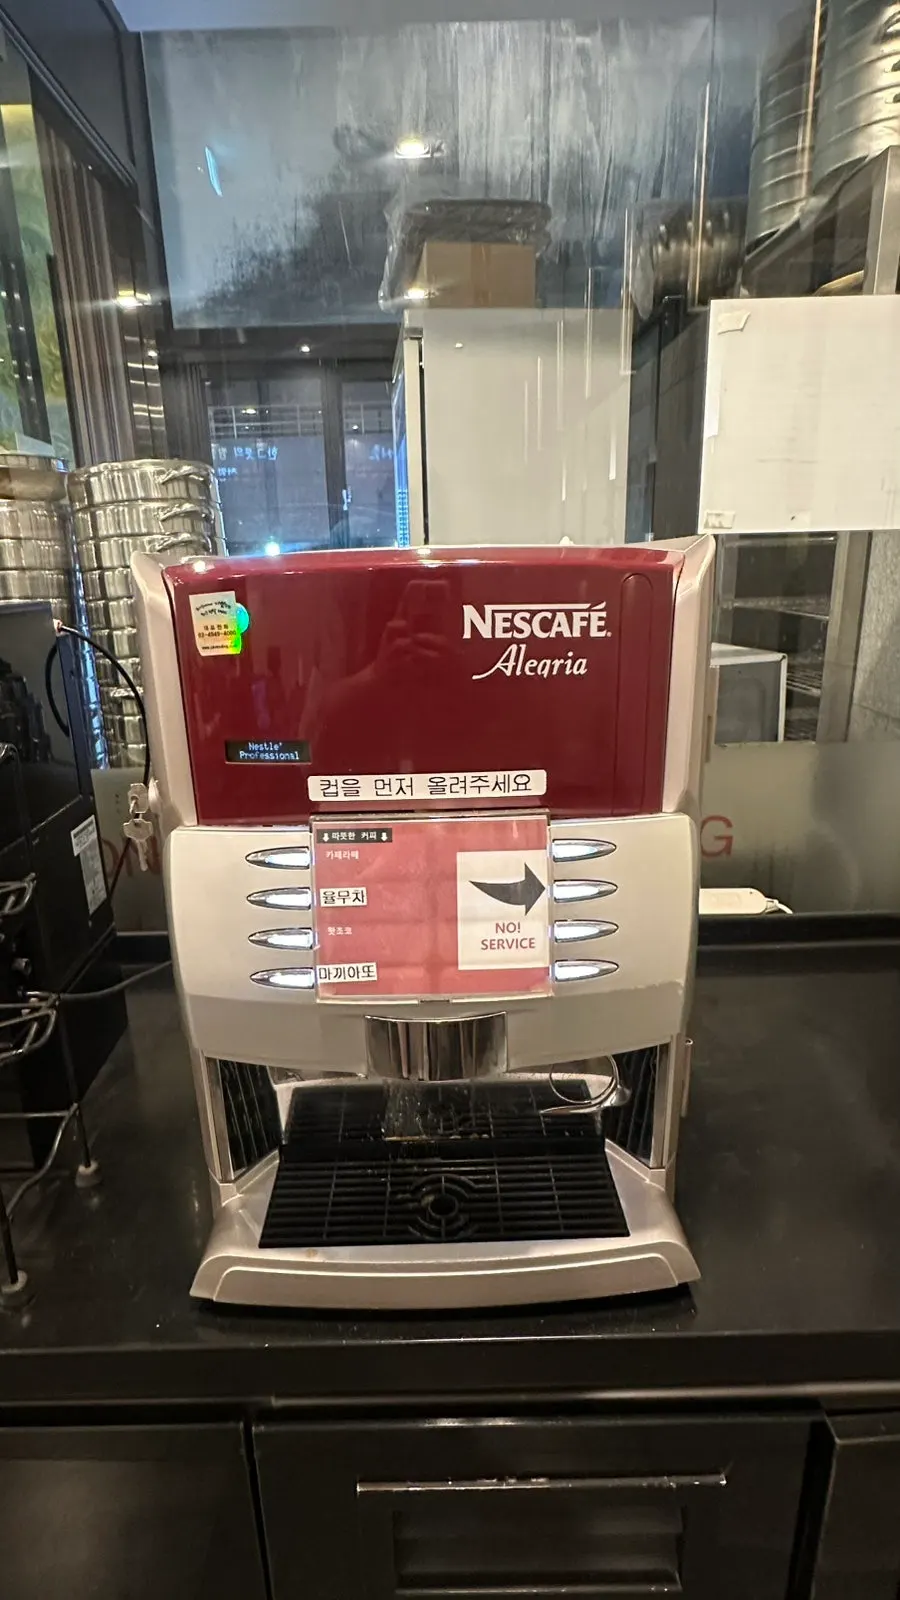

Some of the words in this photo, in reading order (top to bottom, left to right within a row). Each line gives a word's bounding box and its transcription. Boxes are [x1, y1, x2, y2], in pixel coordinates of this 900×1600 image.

[472, 643, 588, 680] Alegria
[239, 751, 300, 760] Professional
[319, 778, 361, 797] 컵을
[374, 777, 414, 797] 먼저
[427, 773, 532, 795] 올려주세요
[331, 831, 356, 841] 따뜻한
[360, 831, 377, 840] 커피
[322, 889, 365, 905] 율무차
[495, 922, 521, 934] NO!
[480, 937, 536, 950] SERVICE
[318, 964, 376, 981] 마끼아또
